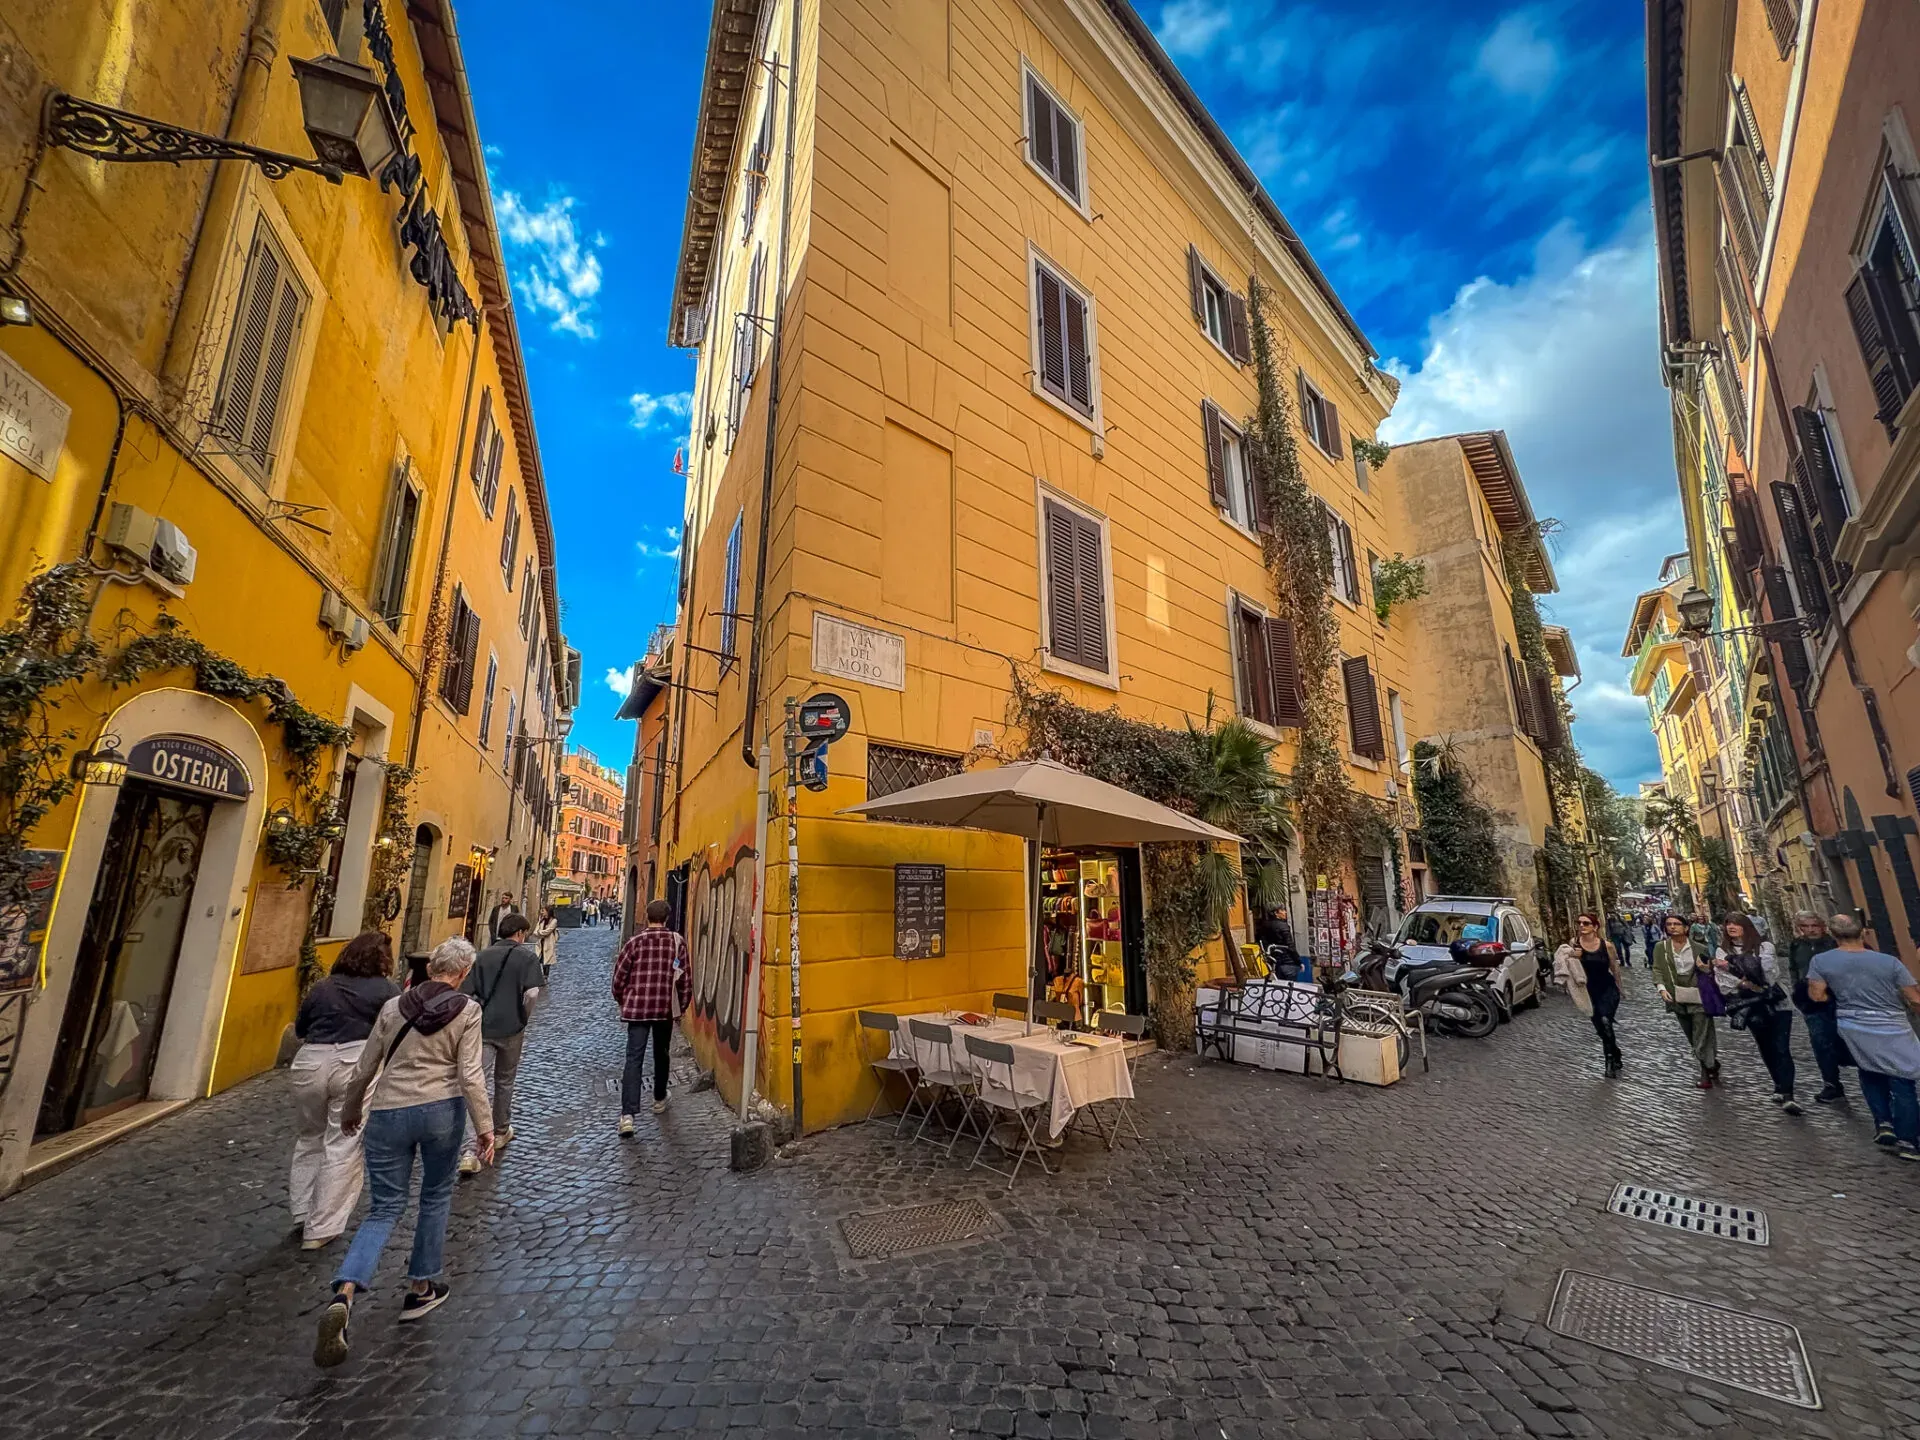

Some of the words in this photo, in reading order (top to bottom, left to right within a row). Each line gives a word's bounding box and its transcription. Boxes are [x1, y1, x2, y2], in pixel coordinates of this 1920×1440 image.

[4, 371, 30, 406] VIA
[0, 395, 33, 434] ELLA
[0, 420, 45, 465] ICCIA
[850, 631, 873, 648] VIA
[851, 646, 871, 661] DEL
[838, 656, 882, 678] MORO
[152, 749, 229, 792] OSTERIA
